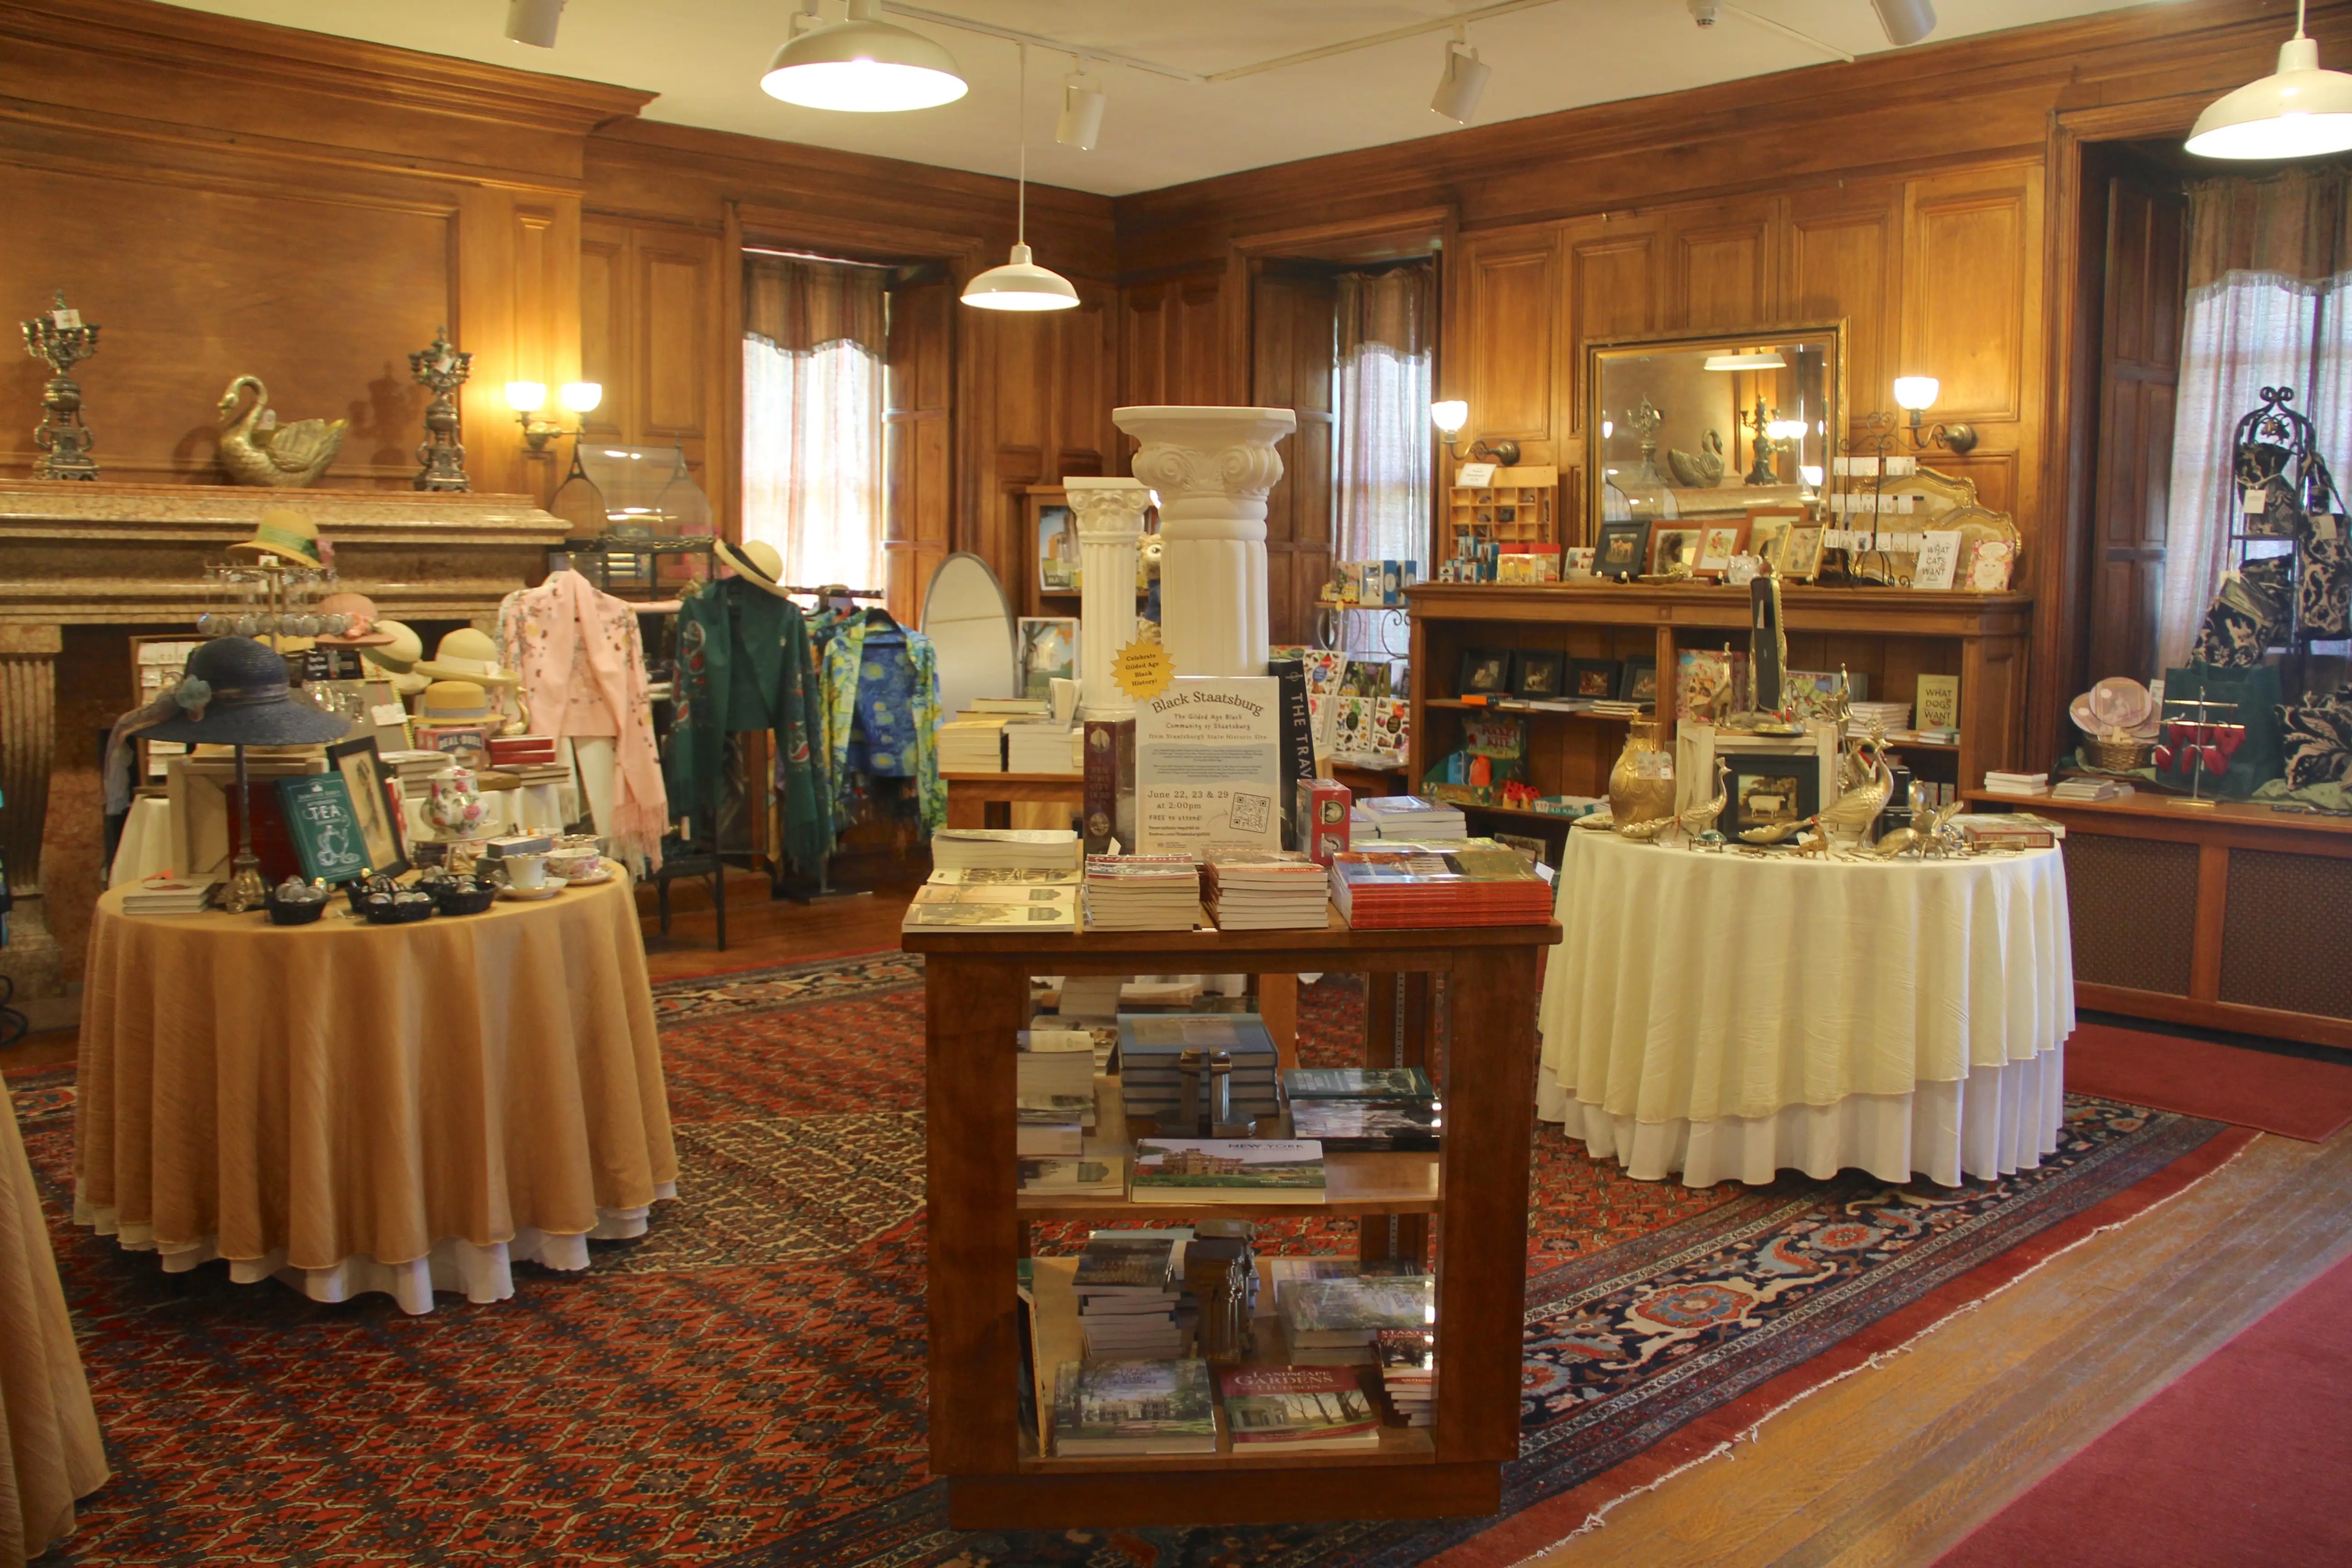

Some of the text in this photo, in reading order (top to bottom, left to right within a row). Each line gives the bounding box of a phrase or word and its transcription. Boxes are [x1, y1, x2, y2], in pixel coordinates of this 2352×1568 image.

[1927, 544, 1950, 554] WHAT
[1926, 557, 1945, 565] CATS
[1922, 568, 1946, 576] WANT
[1126, 653, 1156, 662] Celebrate
[1926, 688, 1952, 697] WHAT
[1152, 691, 1264, 717] Black Staatsburg
[1926, 700, 1951, 709] DOGS
[1925, 711, 1951, 720] WANT
[1291, 692, 1313, 778] THE TRAV
[1169, 802, 1201, 810] 2:00pm
[308, 804, 341, 820] TEA
[1235, 1376, 1333, 1385] GARDENS
